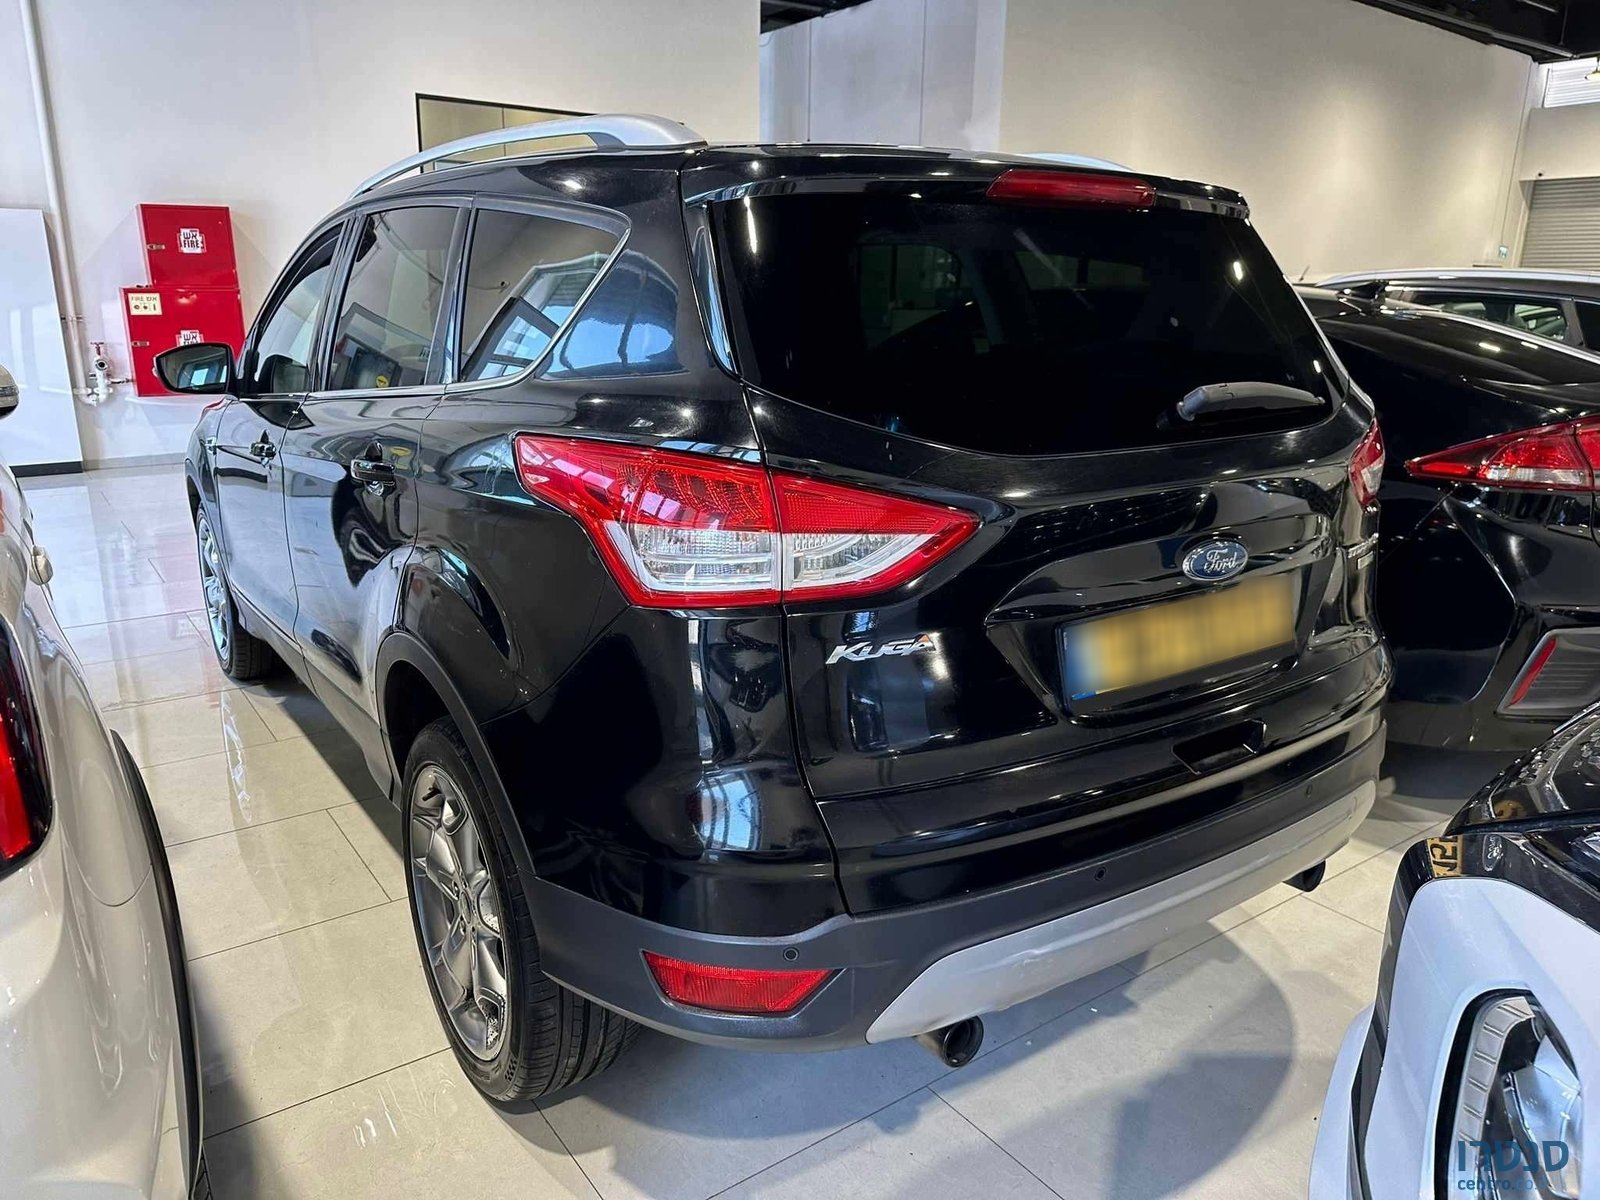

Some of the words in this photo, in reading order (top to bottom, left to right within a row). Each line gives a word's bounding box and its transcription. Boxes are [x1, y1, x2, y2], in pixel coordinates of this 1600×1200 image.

[183, 232, 198, 240] אש
[183, 240, 200, 249] FIRE
[1203, 548, 1240, 573] Ford
[825, 634, 937, 665] KUGA
